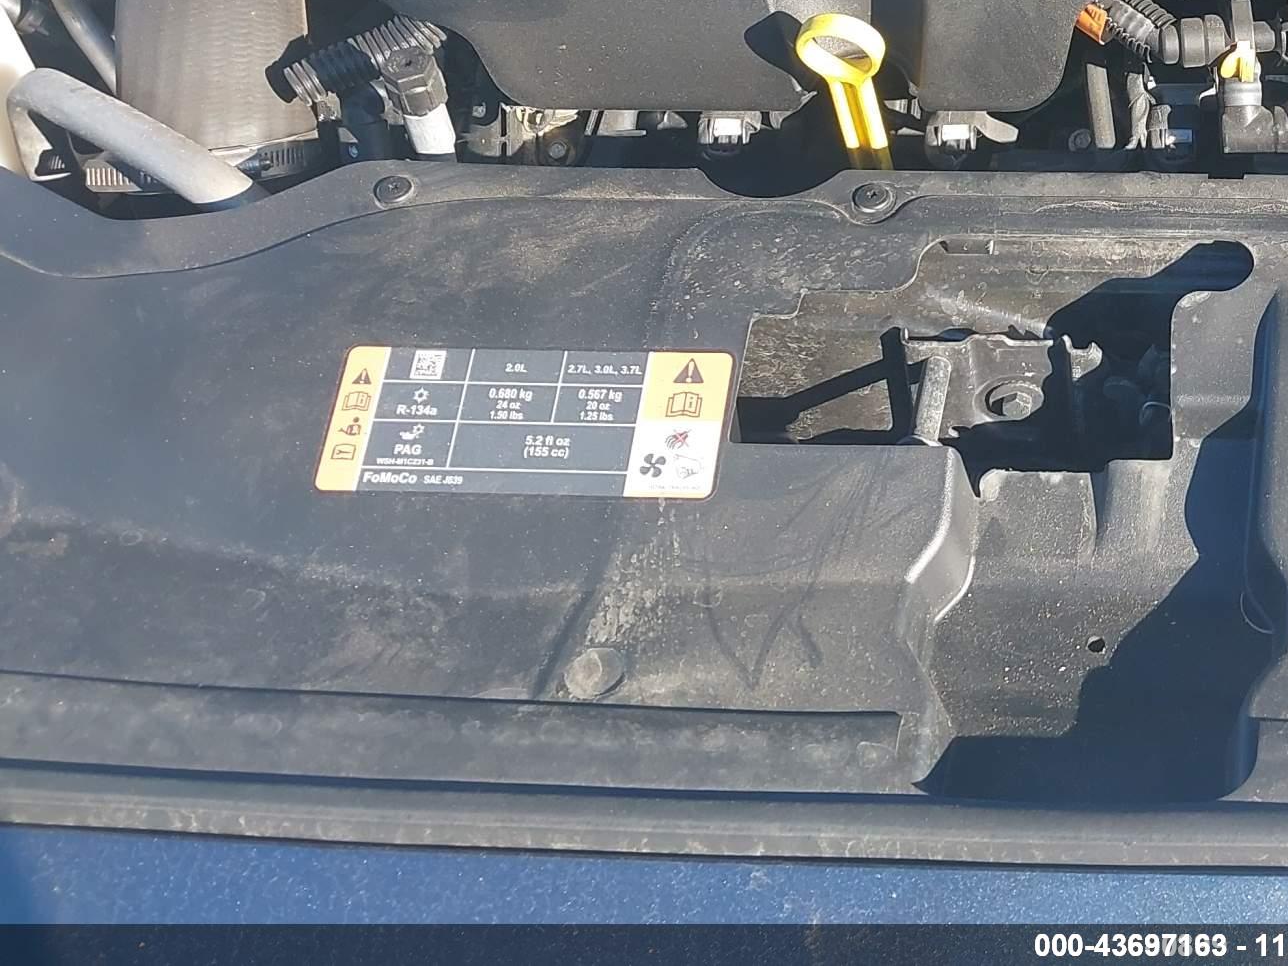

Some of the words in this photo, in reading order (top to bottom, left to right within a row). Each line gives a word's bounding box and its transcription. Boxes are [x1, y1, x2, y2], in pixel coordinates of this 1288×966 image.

[505, 363, 528, 372] 2.0L
[567, 364, 592, 374] 2.7L,
[620, 365, 643, 374] 3.7L
[488, 388, 517, 399] 0.680
[518, 389, 533, 401] kg
[578, 389, 607, 400] 0.567
[608, 389, 623, 402] kg
[496, 400, 508, 409] 24
[585, 401, 598, 410] 20
[598, 402, 611, 410] oz
[396, 405, 438, 415] R-134a
[509, 411, 524, 420] lbs
[579, 411, 598, 420] 1.25
[599, 412, 614, 421] lbs
[525, 436, 543, 446] 5.2
[555, 438, 571, 446] oz
[394, 444, 422, 455] PAG
[524, 447, 549, 458] (155
[550, 447, 569, 458] cc)
[362, 472, 417, 484] FoMoCo
[423, 475, 442, 484] SAE
